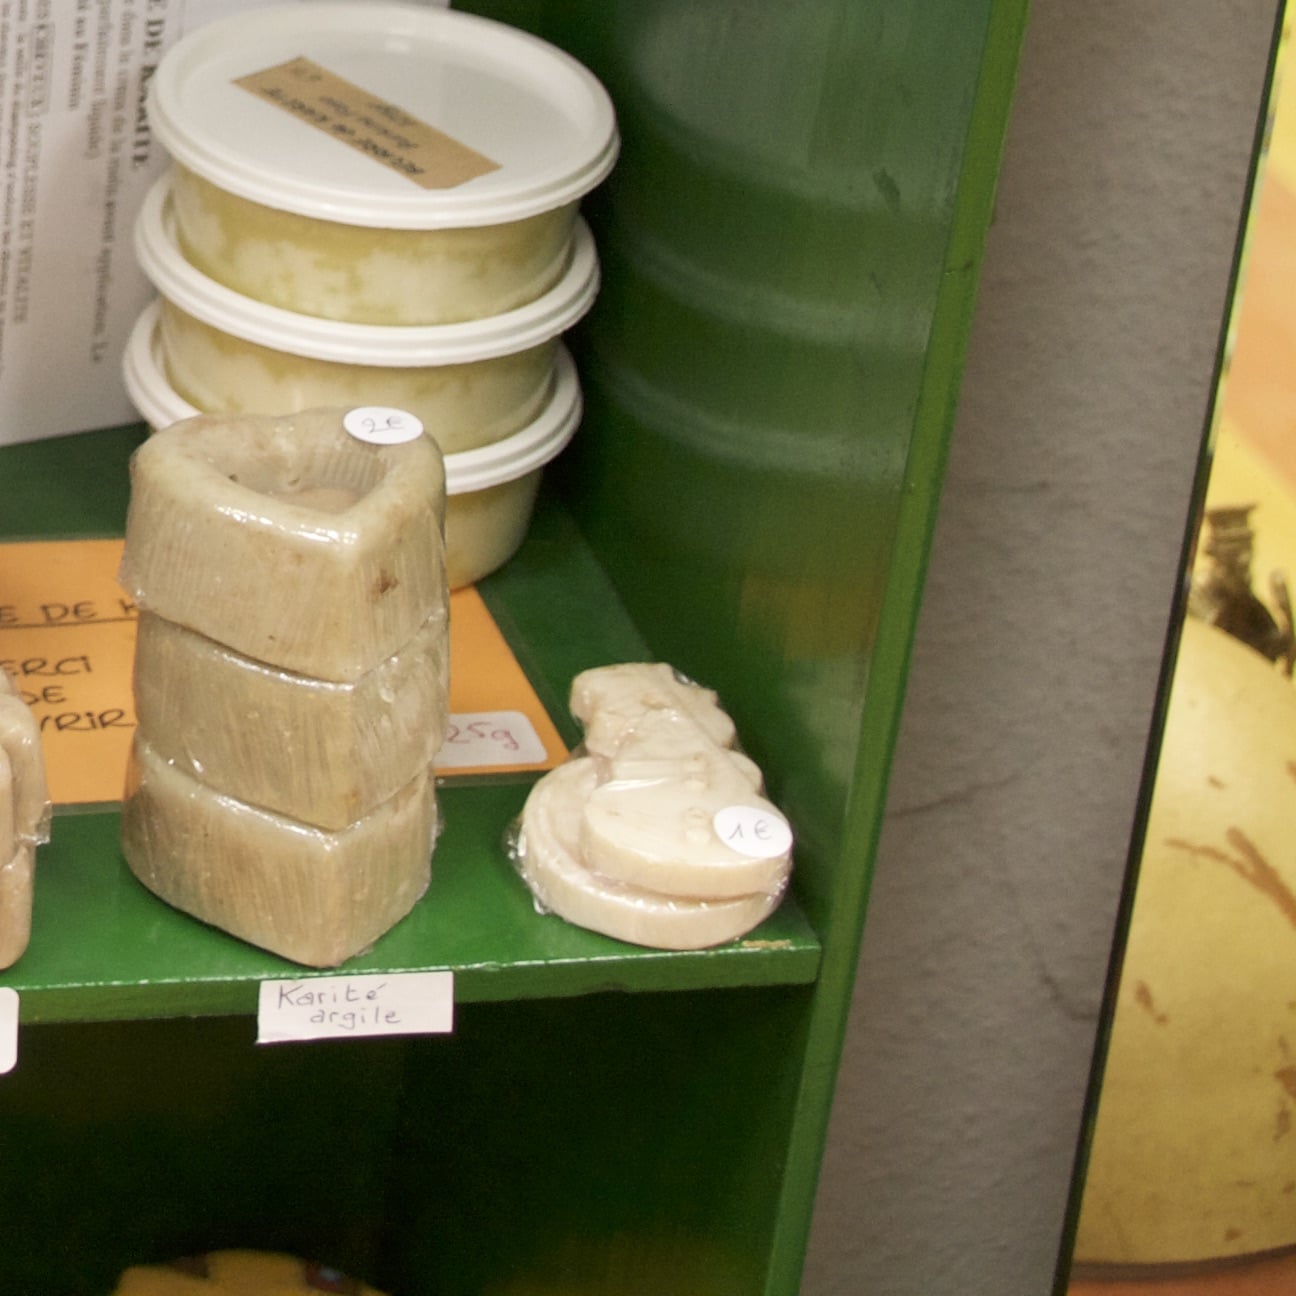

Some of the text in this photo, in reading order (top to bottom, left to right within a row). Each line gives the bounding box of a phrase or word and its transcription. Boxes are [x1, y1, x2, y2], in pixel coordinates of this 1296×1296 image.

[145, 17, 165, 55] DE
[42, 601, 98, 622] DE
[278, 982, 387, 1010] Karité
[310, 1008, 401, 1030] argile
